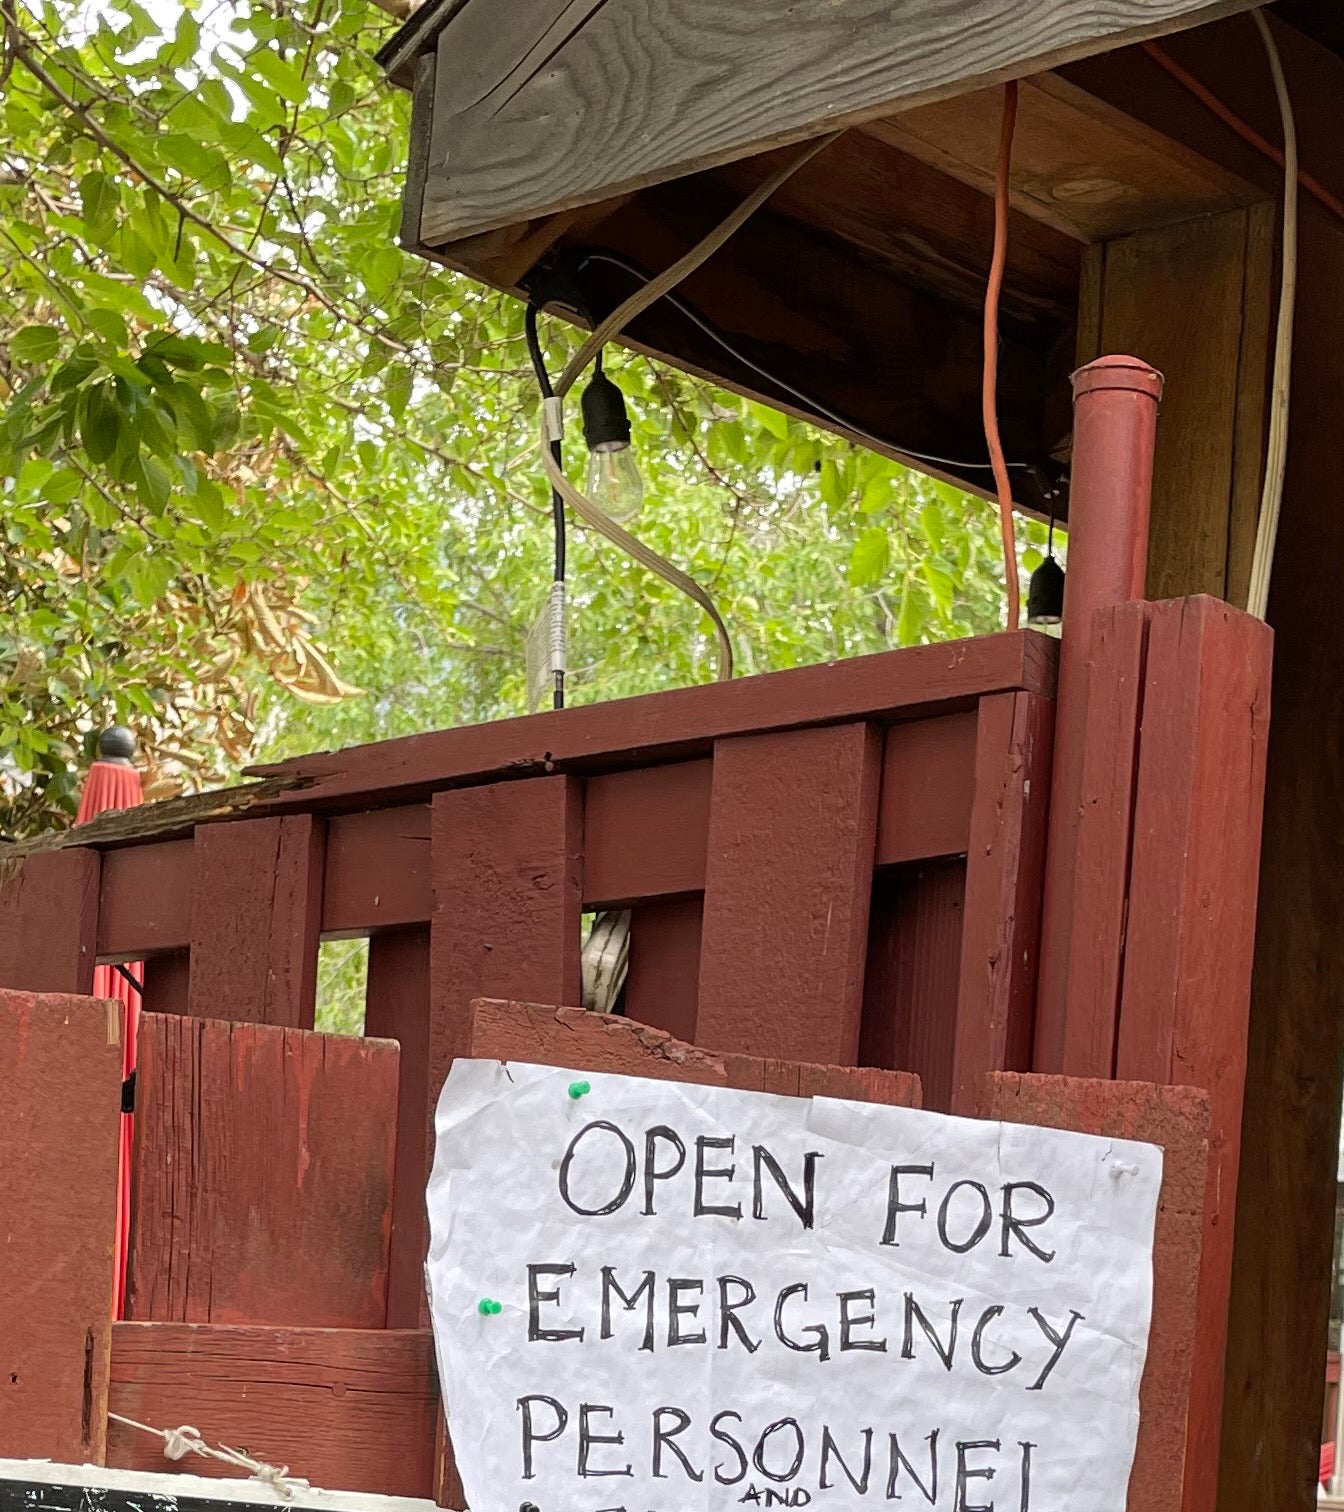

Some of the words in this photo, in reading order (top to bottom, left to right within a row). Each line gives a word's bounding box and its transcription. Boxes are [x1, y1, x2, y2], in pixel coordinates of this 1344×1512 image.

[559, 1120, 825, 1230] OPEN
[879, 1161, 1056, 1263] FOR
[525, 1263, 1086, 1391] EMERGENCY
[738, 1483, 812, 1508] AND
